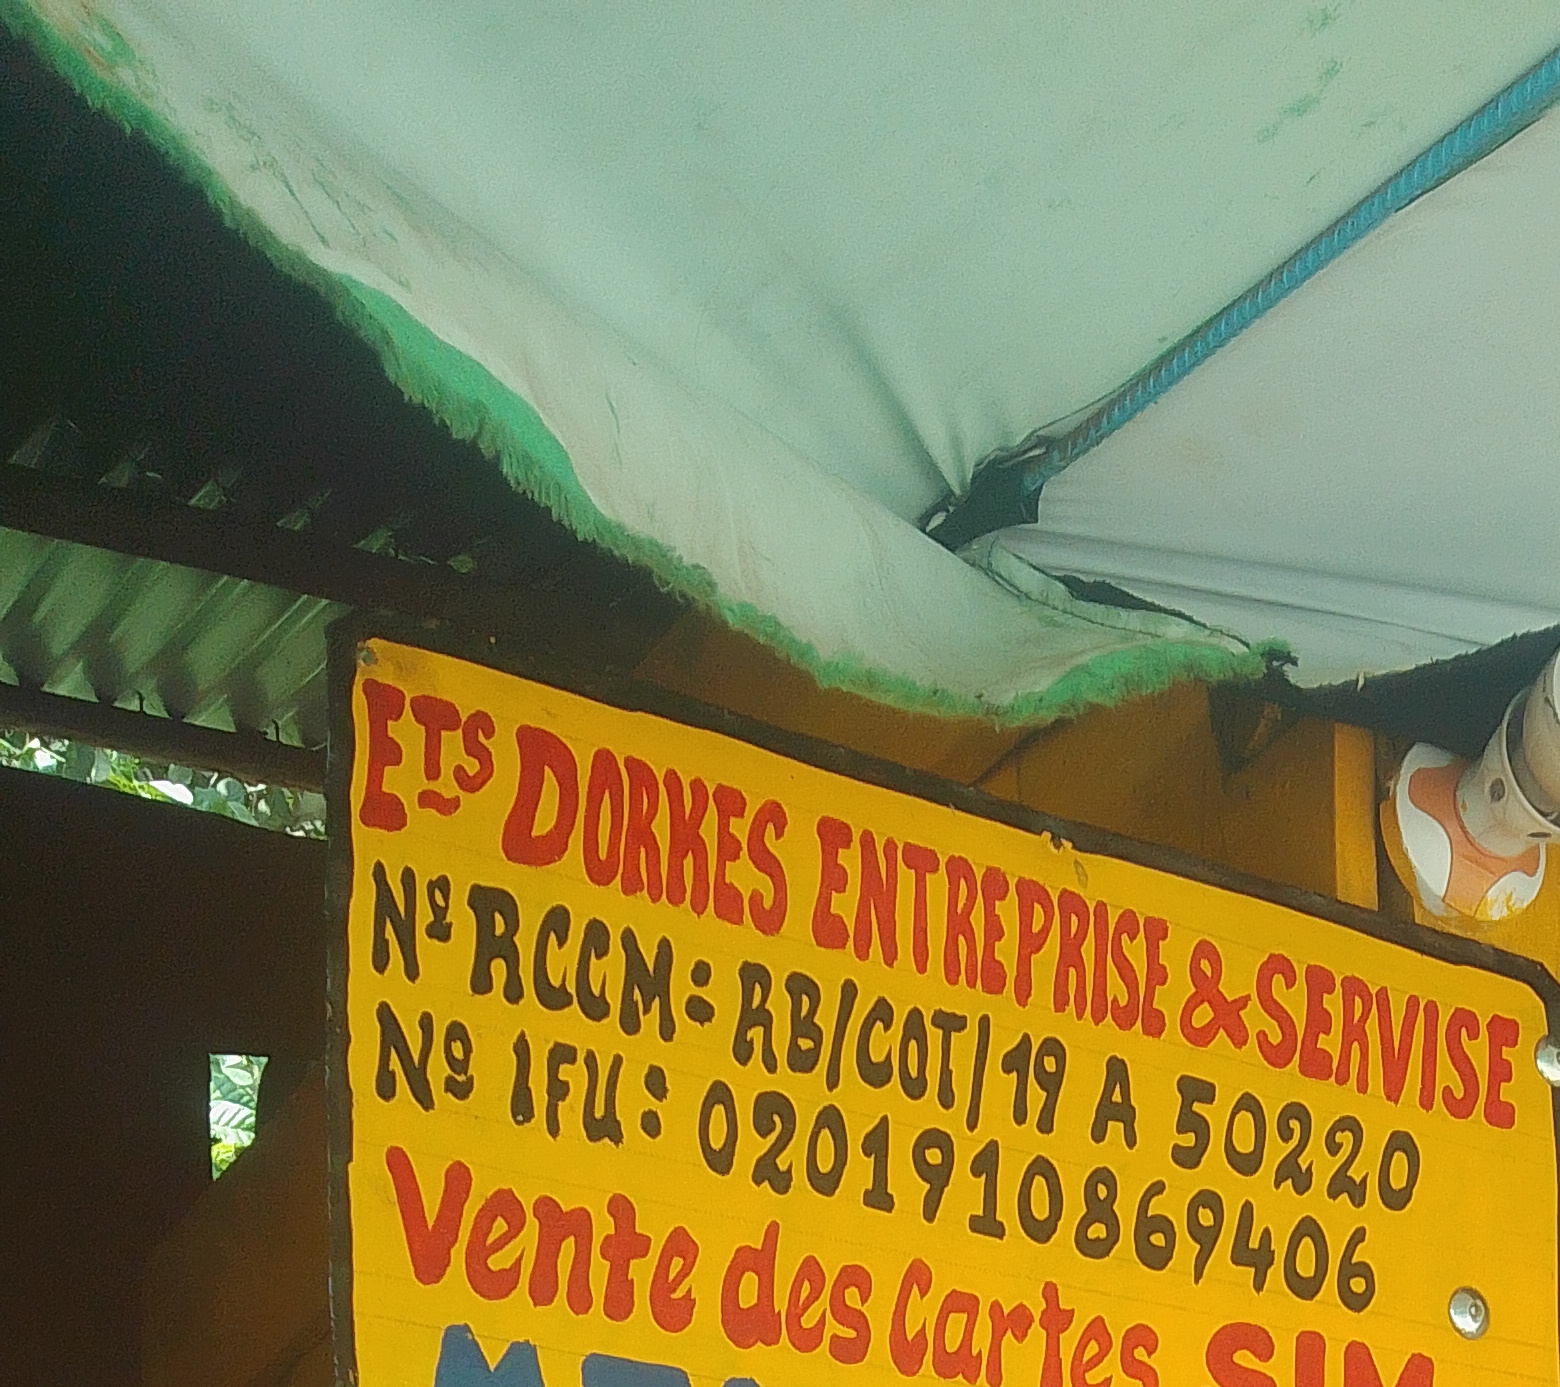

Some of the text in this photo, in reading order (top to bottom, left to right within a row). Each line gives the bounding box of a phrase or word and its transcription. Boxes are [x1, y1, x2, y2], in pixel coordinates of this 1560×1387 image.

[360, 678, 1521, 1130] ETS DORKES ENTREPRISE & SERVISE
[697, 1079, 1376, 1313] 0201910869406
[732, 960, 1067, 1135] RB/COT/19
[1091, 1055, 1138, 1151] A
[1171, 1074, 1421, 1212] 50220
[385, 1144, 700, 1335] Vente
[719, 1219, 872, 1366] des
